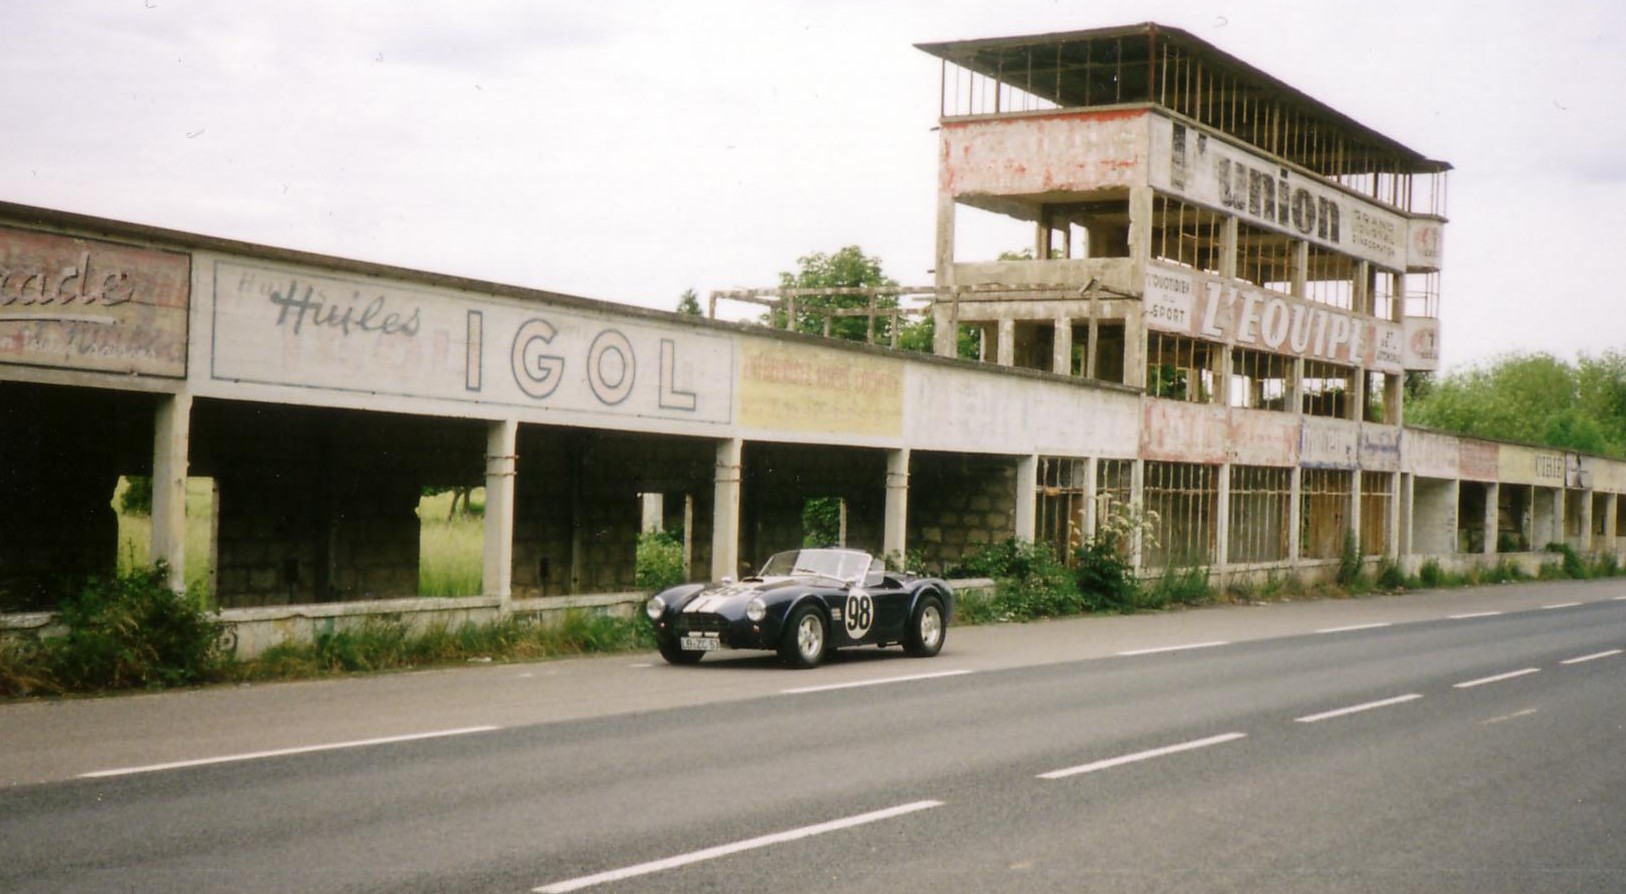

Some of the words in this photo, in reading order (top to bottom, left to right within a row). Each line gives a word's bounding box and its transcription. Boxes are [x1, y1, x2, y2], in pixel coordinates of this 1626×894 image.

[270, 280, 420, 336] Huiles
[1153, 303, 1185, 324] SPORT
[465, 309, 698, 412] IGOL
[847, 595, 871, 631] 98
